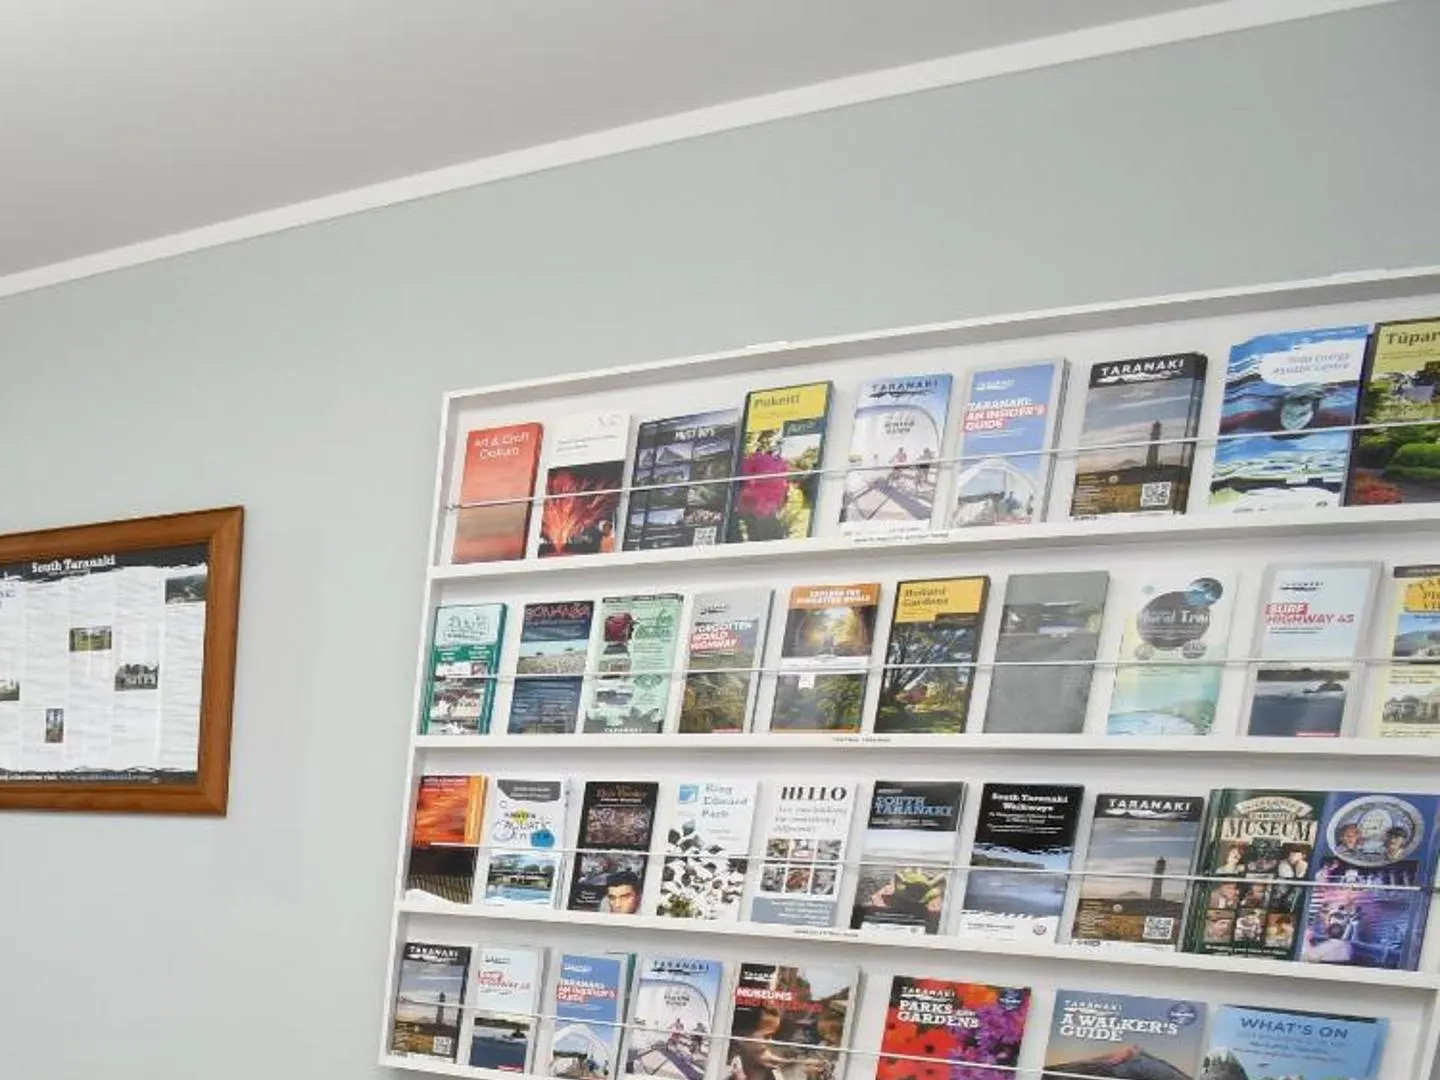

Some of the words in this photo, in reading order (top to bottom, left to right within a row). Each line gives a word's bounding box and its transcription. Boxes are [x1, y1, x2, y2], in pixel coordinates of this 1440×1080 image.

[1101, 358, 1185, 376] TARANAKI
[871, 378, 939, 392] TARANAKI
[964, 418, 1003, 431] GUIDE
[31, 561, 62, 573] South
[63, 554, 116, 570] Taranaki
[1270, 603, 1304, 615] SURF
[1266, 613, 1334, 625] HIGHWAY
[693, 621, 752, 634] FORGOTTEN
[692, 631, 729, 643] WORLD
[690, 639, 738, 651] HIGHWAY
[780, 785, 847, 801] HELLO
[991, 792, 1020, 802] South
[1021, 793, 1069, 804] Taranaki
[875, 796, 925, 806] SOUTH
[1002, 802, 1055, 813] Walkways
[1109, 799, 1193, 812] TARANAKI
[875, 804, 953, 817] TARANAKI
[1222, 820, 1311, 842] MUSEUM
[409, 945, 459, 960] TARANAKI
[736, 988, 792, 1001] MUSEUMS
[901, 986, 956, 998] TARANAKI
[899, 999, 953, 1015] PARKS
[1064, 1000, 1123, 1011] TARANAKI
[897, 1010, 980, 1029] GARDENS
[1060, 1013, 1074, 1025] A
[1078, 1014, 1179, 1036] WALKER'S
[1060, 1024, 1124, 1041] GUIDE
[1240, 1016, 1313, 1036] WHAT'S
[1318, 1025, 1349, 1040] ON
